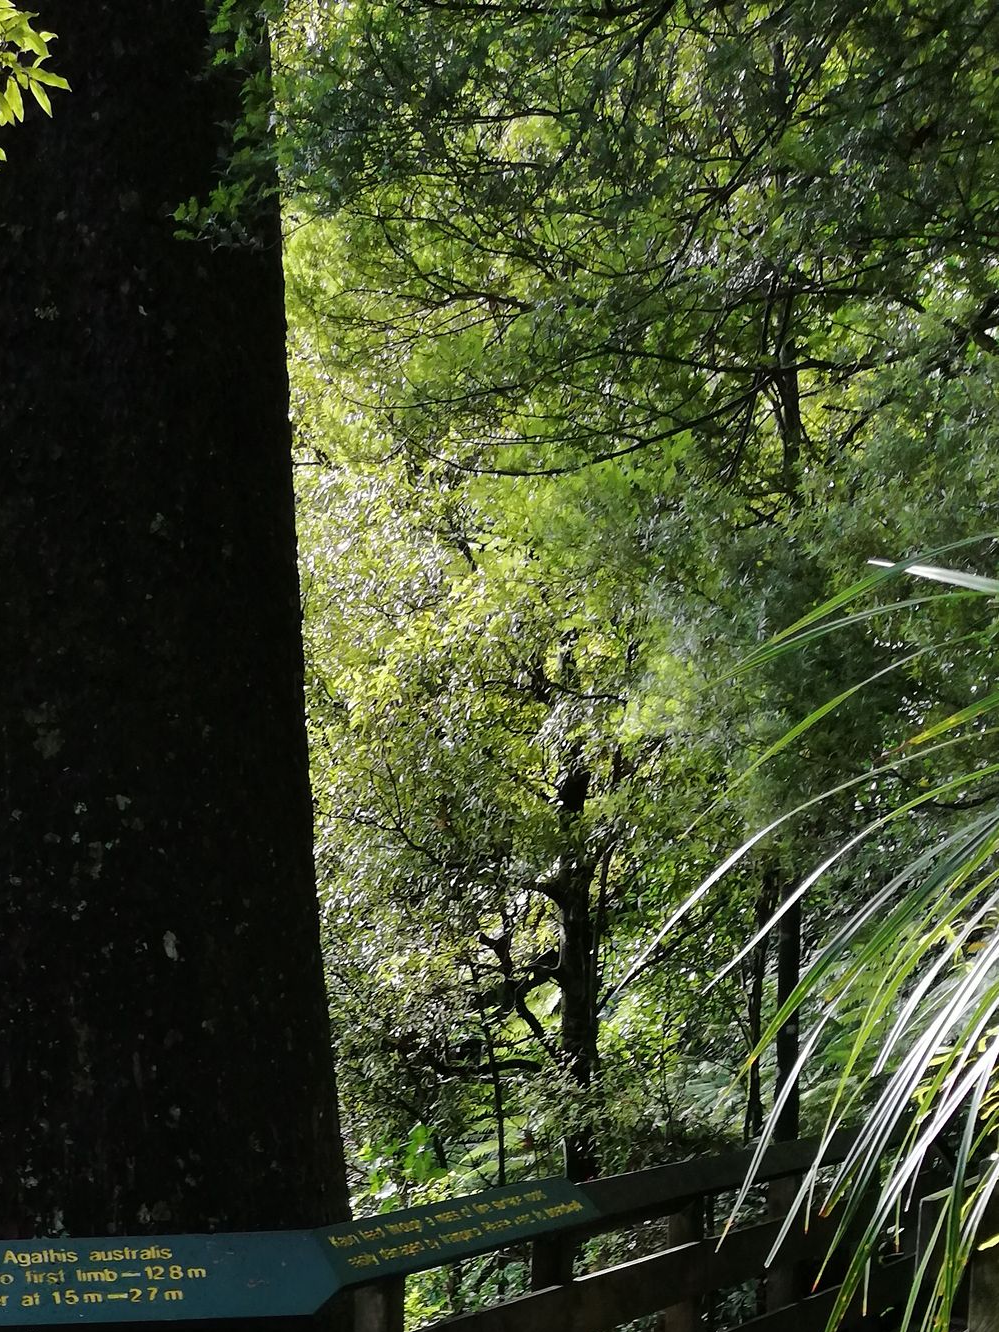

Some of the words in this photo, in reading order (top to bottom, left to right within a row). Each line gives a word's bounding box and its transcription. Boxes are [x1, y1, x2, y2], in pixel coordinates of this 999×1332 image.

[3, 1248, 78, 1267] Agathis
[89, 1245, 172, 1261] australis
[25, 1270, 65, 1284] first
[21, 1292, 40, 1307] at
